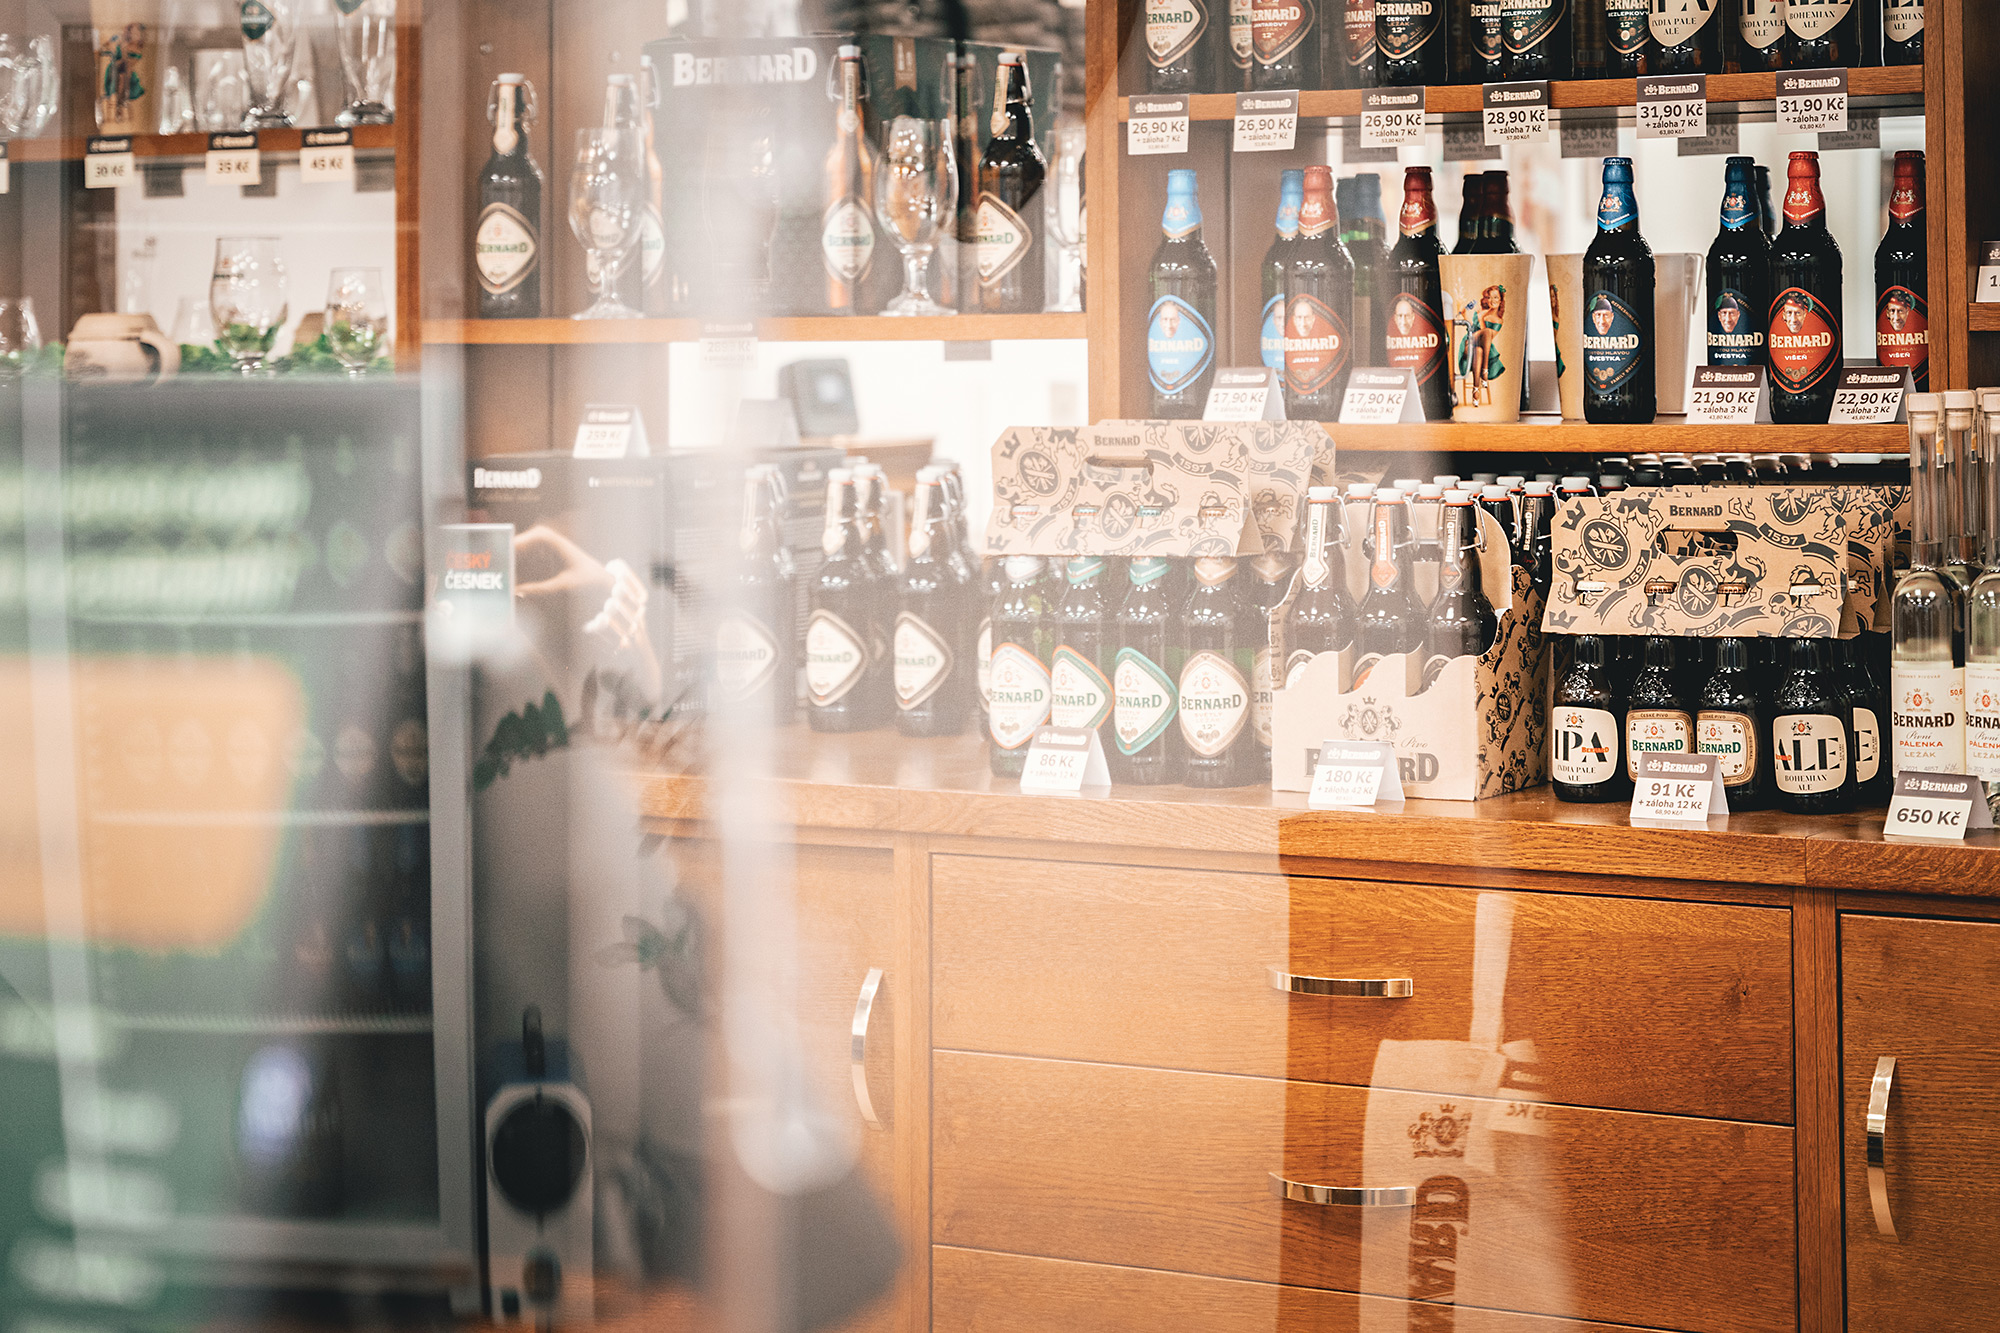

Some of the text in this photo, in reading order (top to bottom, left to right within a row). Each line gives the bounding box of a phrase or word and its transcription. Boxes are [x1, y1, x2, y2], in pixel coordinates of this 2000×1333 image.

[1252, 6, 1300, 22] ERNARD
[1375, 2, 1433, 16] BERNARD
[1789, 10, 1836, 20] BOHEMIAN
[1147, 10, 1193, 24] ERNARD
[1651, 17, 1697, 28] INDIA PALE
[1802, 20, 1819, 28] ALE
[1663, 27, 1680, 35] ALE
[1753, 28, 1769, 37] ALE
[1893, 22, 1908, 31] ALE
[673, 47, 817, 86] BERARD
[1658, 83, 1699, 95] BERNARD
[1797, 76, 1841, 89] BERNARD
[1381, 93, 1419, 105] BERNARD
[1502, 89, 1542, 102] BERNARD
[1640, 103, 1703, 121] 31,90 Kč
[1780, 97, 1845, 115] 31,90 Kč
[1237, 117, 1293, 132] 26,90 Kč
[1364, 113, 1422, 130] 26,90 Kč
[1487, 110, 1546, 127] 28,90 Kč
[1652, 119, 1679, 129] záloha
[1688, 119, 1698, 127] Kč
[1792, 113, 1839, 124] záloha 7 Kč
[1132, 120, 1186, 136] 26,90 Kč
[1375, 128, 1417, 137] záloha 7 Kč
[1499, 125, 1524, 135] záloha
[1532, 125, 1541, 133] Kč
[1149, 337, 1204, 352] BERNARD
[1284, 335, 1340, 351] BERNARD
[1386, 333, 1439, 350] BERNARD
[1583, 333, 1640, 350] BERNARD
[1707, 331, 1764, 347] BERNARD
[1771, 331, 1831, 348] BERNARD
[1877, 330, 1928, 346] BERNAR
[1292, 356, 1320, 364] JANTAR
[1588, 354, 1621, 362] ŠVESTKA
[1713, 371, 1756, 383] BERNARD
[1860, 373, 1900, 384] BERNARD
[1213, 392, 1264, 404] 17,90 Kč
[1348, 393, 1402, 406] 17,90 Kč
[1692, 391, 1756, 407] 21,90 Kč
[1836, 391, 1899, 407] 22,90 Kč
[1703, 405, 1729, 414] záloha
[1737, 405, 1748, 414] Kč
[1846, 406, 1890, 415] záloha 3 Kč
[1094, 434, 1141, 447] BERNARD
[1179, 457, 1207, 474] 1597
[1669, 504, 1723, 517] BERNARD
[1310, 518, 1319, 558] BERNARD
[1523, 510, 1533, 551] BERNARD
[1767, 529, 1798, 546] 1597
[1378, 520, 1387, 561] BERNARD
[1445, 521, 1455, 563] BERNARD
[445, 568, 504, 590] ČESNEK
[1625, 558, 1649, 585] 1597
[1691, 620, 1723, 637] 1597
[987, 688, 1044, 703] ERNARD
[1052, 692, 1097, 707] RNARD
[1115, 694, 1162, 708] ERNARD
[1181, 693, 1242, 711] BERNARD
[1893, 711, 1955, 728] BERNARD
[1965, 711, 2000, 729] BERNA
[1554, 728, 1608, 763] IPA
[1632, 738, 1684, 752] BERNARD
[1698, 740, 1742, 755] BERNARD
[1899, 740, 1944, 748] PÁLENKA
[1969, 740, 2000, 749] PÁLENK
[1039, 753, 1074, 768] 86 Kč
[1775, 737, 1841, 771] ALE
[1904, 750, 1936, 758] LEŽÁK
[1576, 766, 1596, 774] PALE
[1661, 761, 1708, 775] BERNARD
[1325, 770, 1374, 785] 180 Kč
[1784, 774, 1828, 783] BOHEMIAN
[1324, 785, 1349, 794] záloha
[1363, 786, 1375, 795] Kč
[1650, 782, 1696, 798] 91 Kč
[1920, 780, 1968, 793] BERNARD
[1646, 799, 1703, 810] záloha 12 Kč
[1896, 807, 1961, 826] 650 Kč
